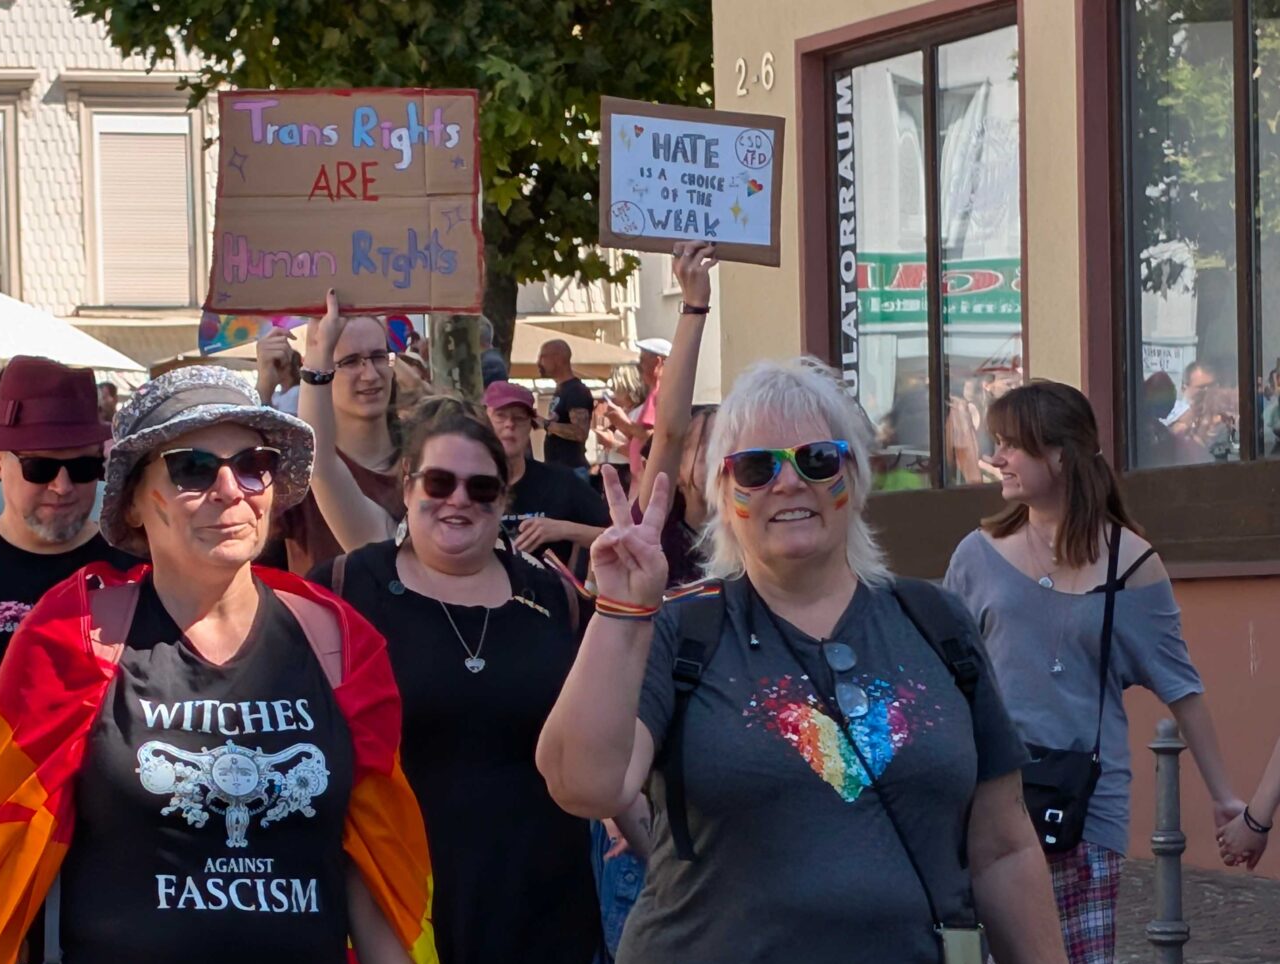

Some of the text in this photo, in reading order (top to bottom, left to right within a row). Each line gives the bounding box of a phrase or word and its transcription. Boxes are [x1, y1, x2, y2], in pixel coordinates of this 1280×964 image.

[735, 51, 775, 96] 2-6
[232, 99, 461, 171] Trans Rights
[651, 132, 720, 169] HATE
[307, 160, 380, 202] ARE
[639, 167, 725, 192] IS A CHOICE
[660, 186, 713, 208] OF THE
[646, 207, 721, 238] WEAK
[222, 228, 458, 290] Human Rights
[139, 699, 315, 736] WITCHES
[204, 857, 275, 873] AGAINST
[155, 874, 320, 913] FASCISM
